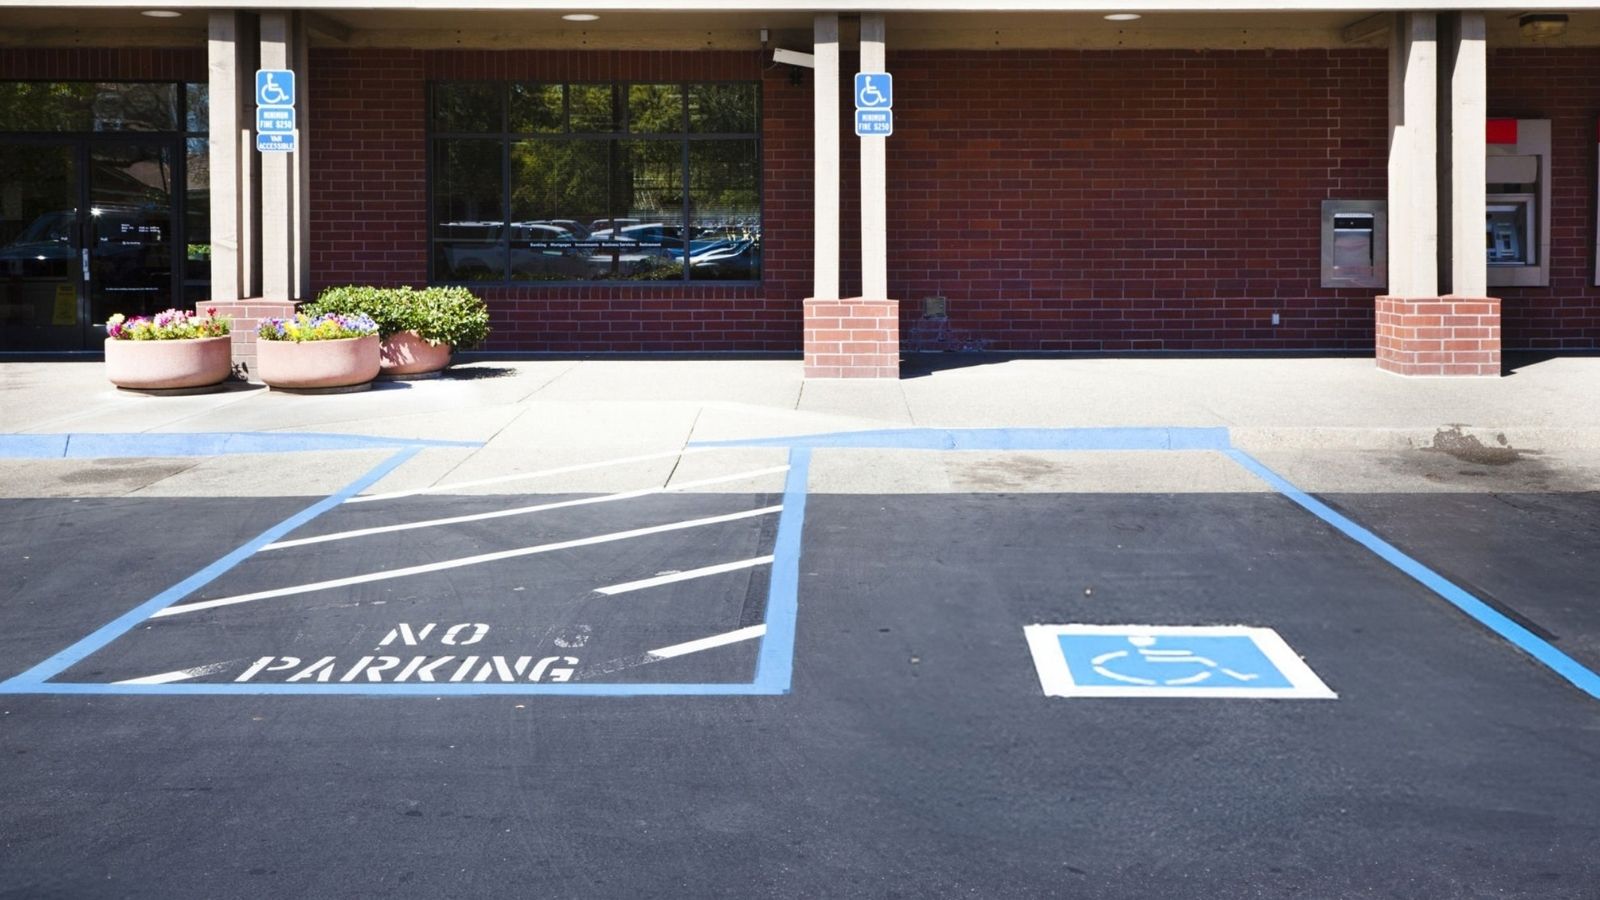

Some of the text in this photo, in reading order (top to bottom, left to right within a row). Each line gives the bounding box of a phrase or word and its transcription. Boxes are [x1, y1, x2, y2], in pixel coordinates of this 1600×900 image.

[260, 120, 292, 129] FINE $250
[858, 122, 890, 131] FINE $250
[259, 142, 295, 150] ACCESSIBLE
[374, 622, 490, 651] NO
[234, 655, 580, 682] PARKING
